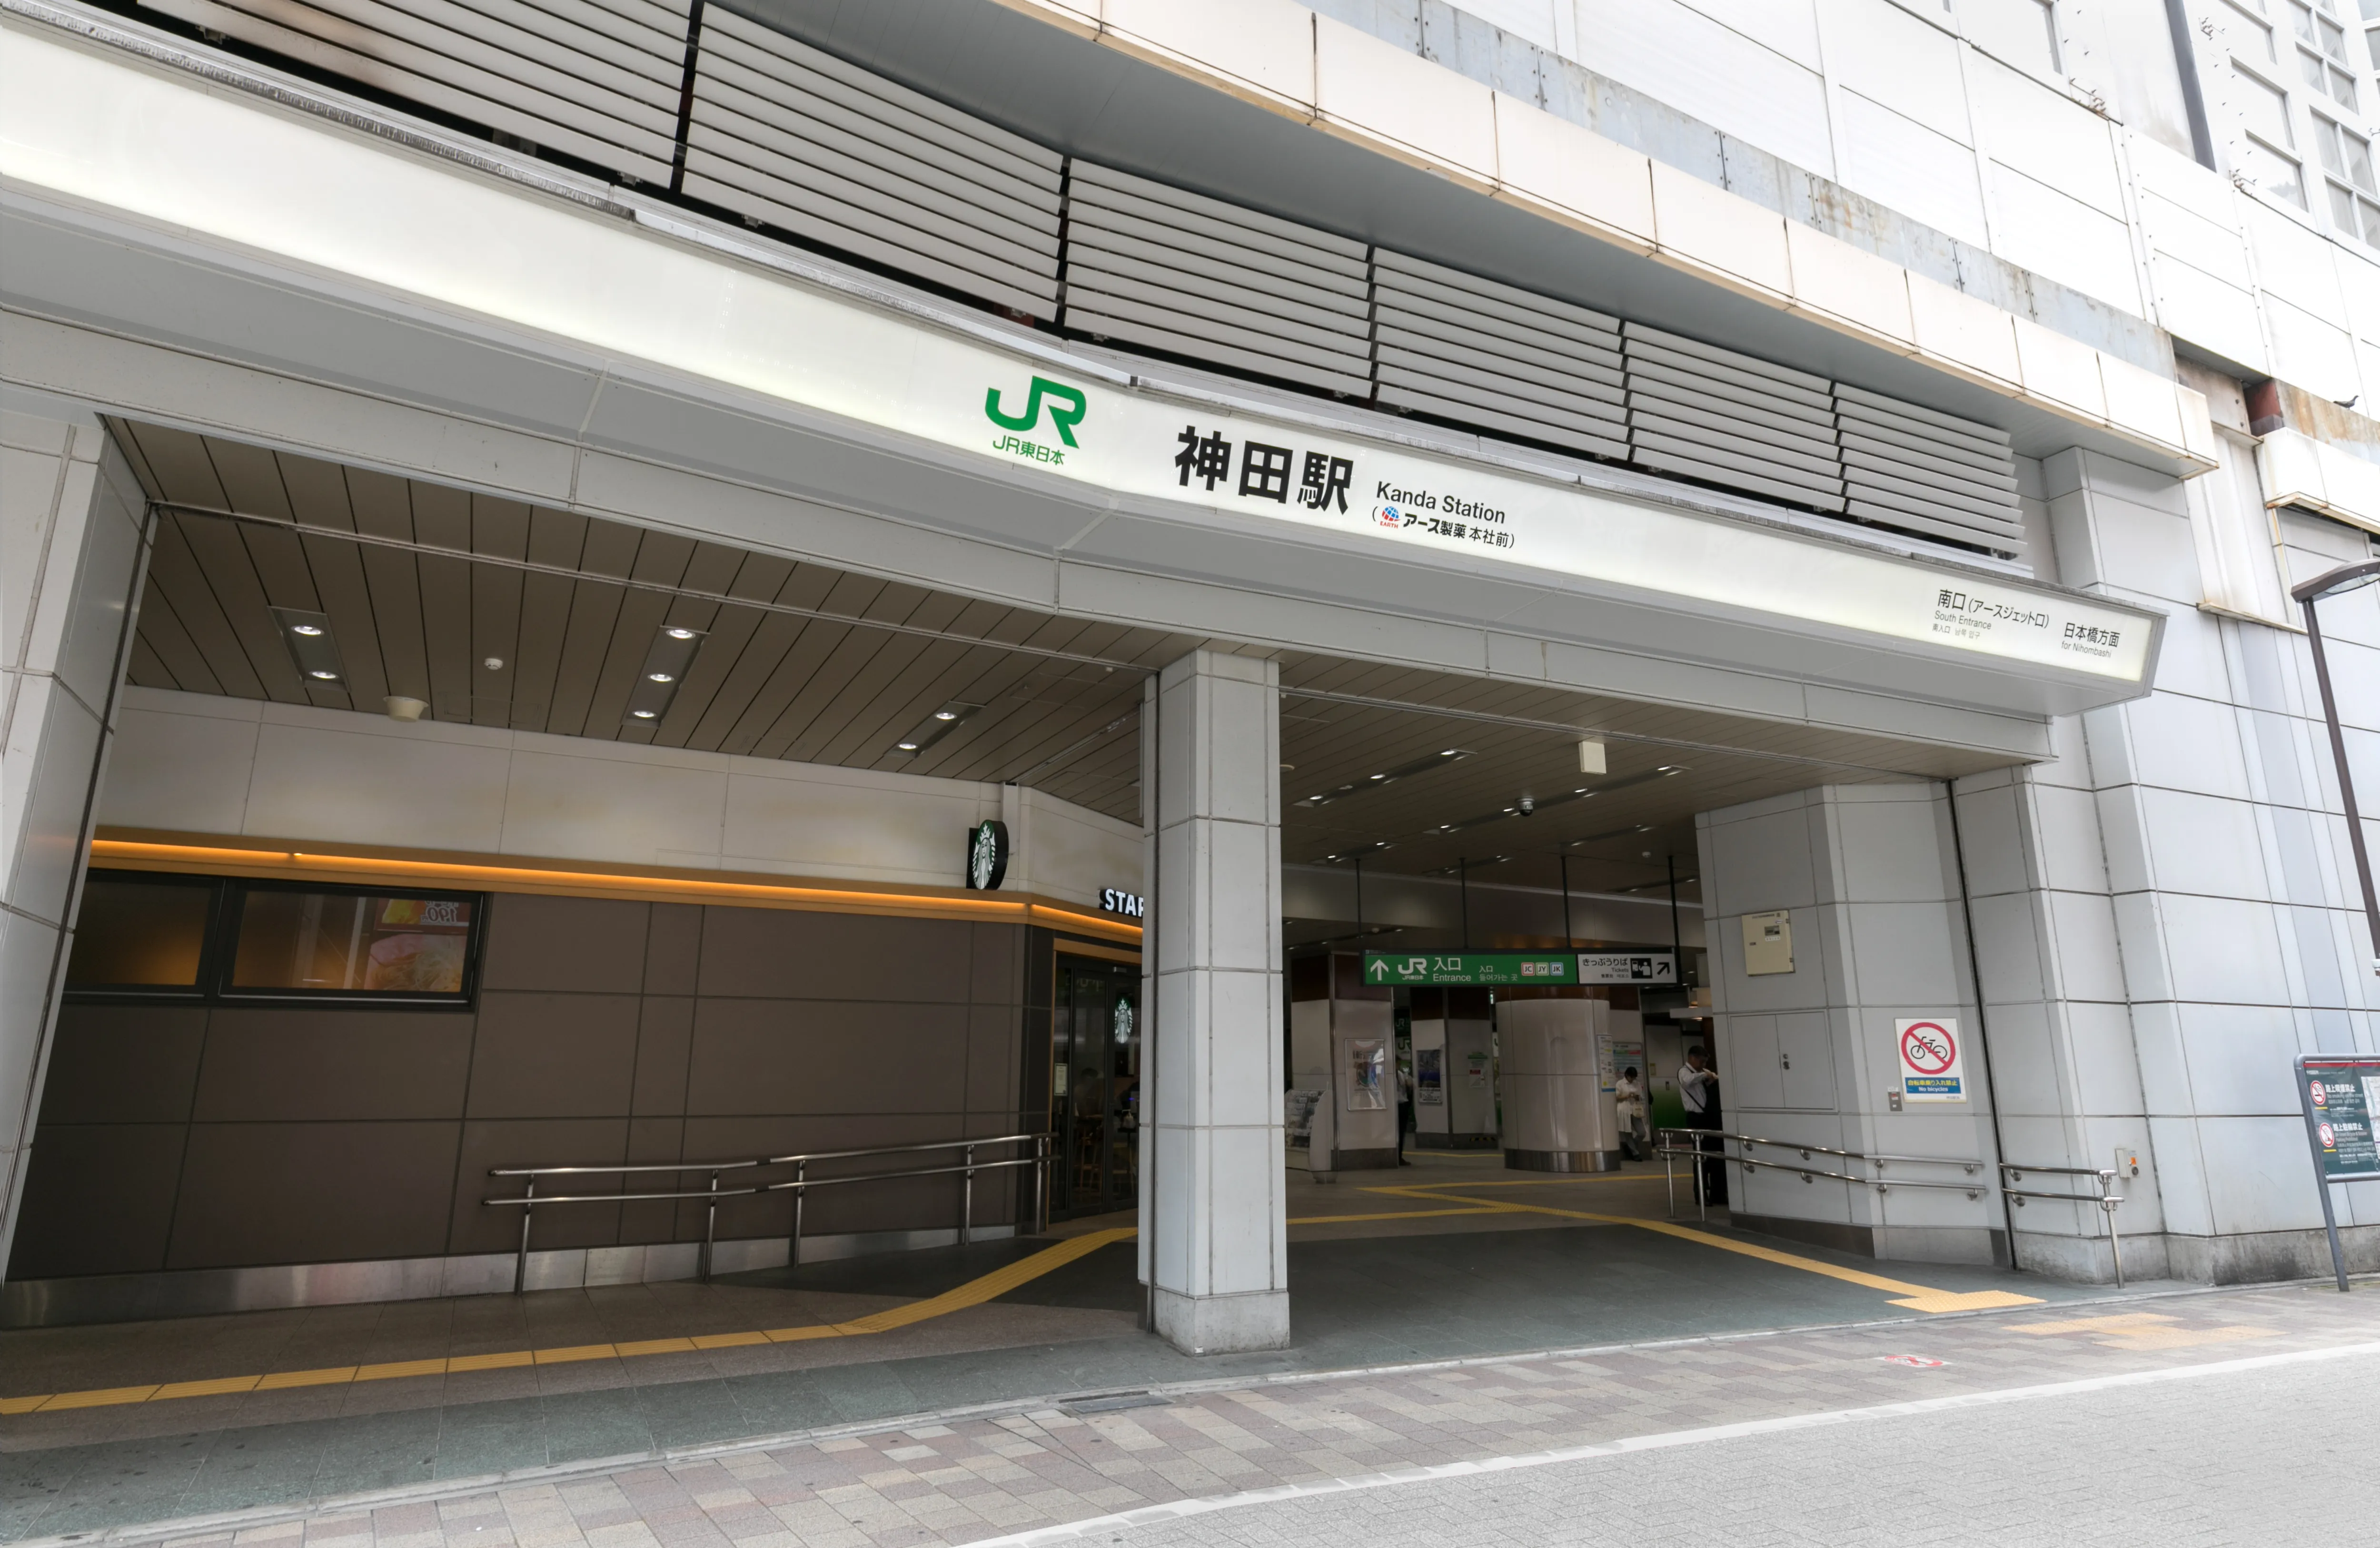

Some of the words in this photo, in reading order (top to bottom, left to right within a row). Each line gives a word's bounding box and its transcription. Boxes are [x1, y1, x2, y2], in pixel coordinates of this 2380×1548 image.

[985, 375, 1087, 449] JR
[993, 435, 1065, 466] JR東日本
[1174, 425, 1354, 515] 神田駅
[1376, 481, 1436, 510] Kanda
[1442, 495, 1505, 524] Station
[1932, 623, 1951, 633] 南入口
[1934, 611, 1956, 624] South
[1959, 615, 1992, 631] Entrance
[1969, 631, 1980, 640] 입구
[2063, 622, 2121, 648] 日本橋方面
[2061, 641, 2071, 650] for
[2073, 642, 2112, 659] Nihombashi
[1398, 958, 1427, 974] JR
[1433, 957, 1461, 971] 入口
[1582, 958, 1628, 966] きっぷうりば
